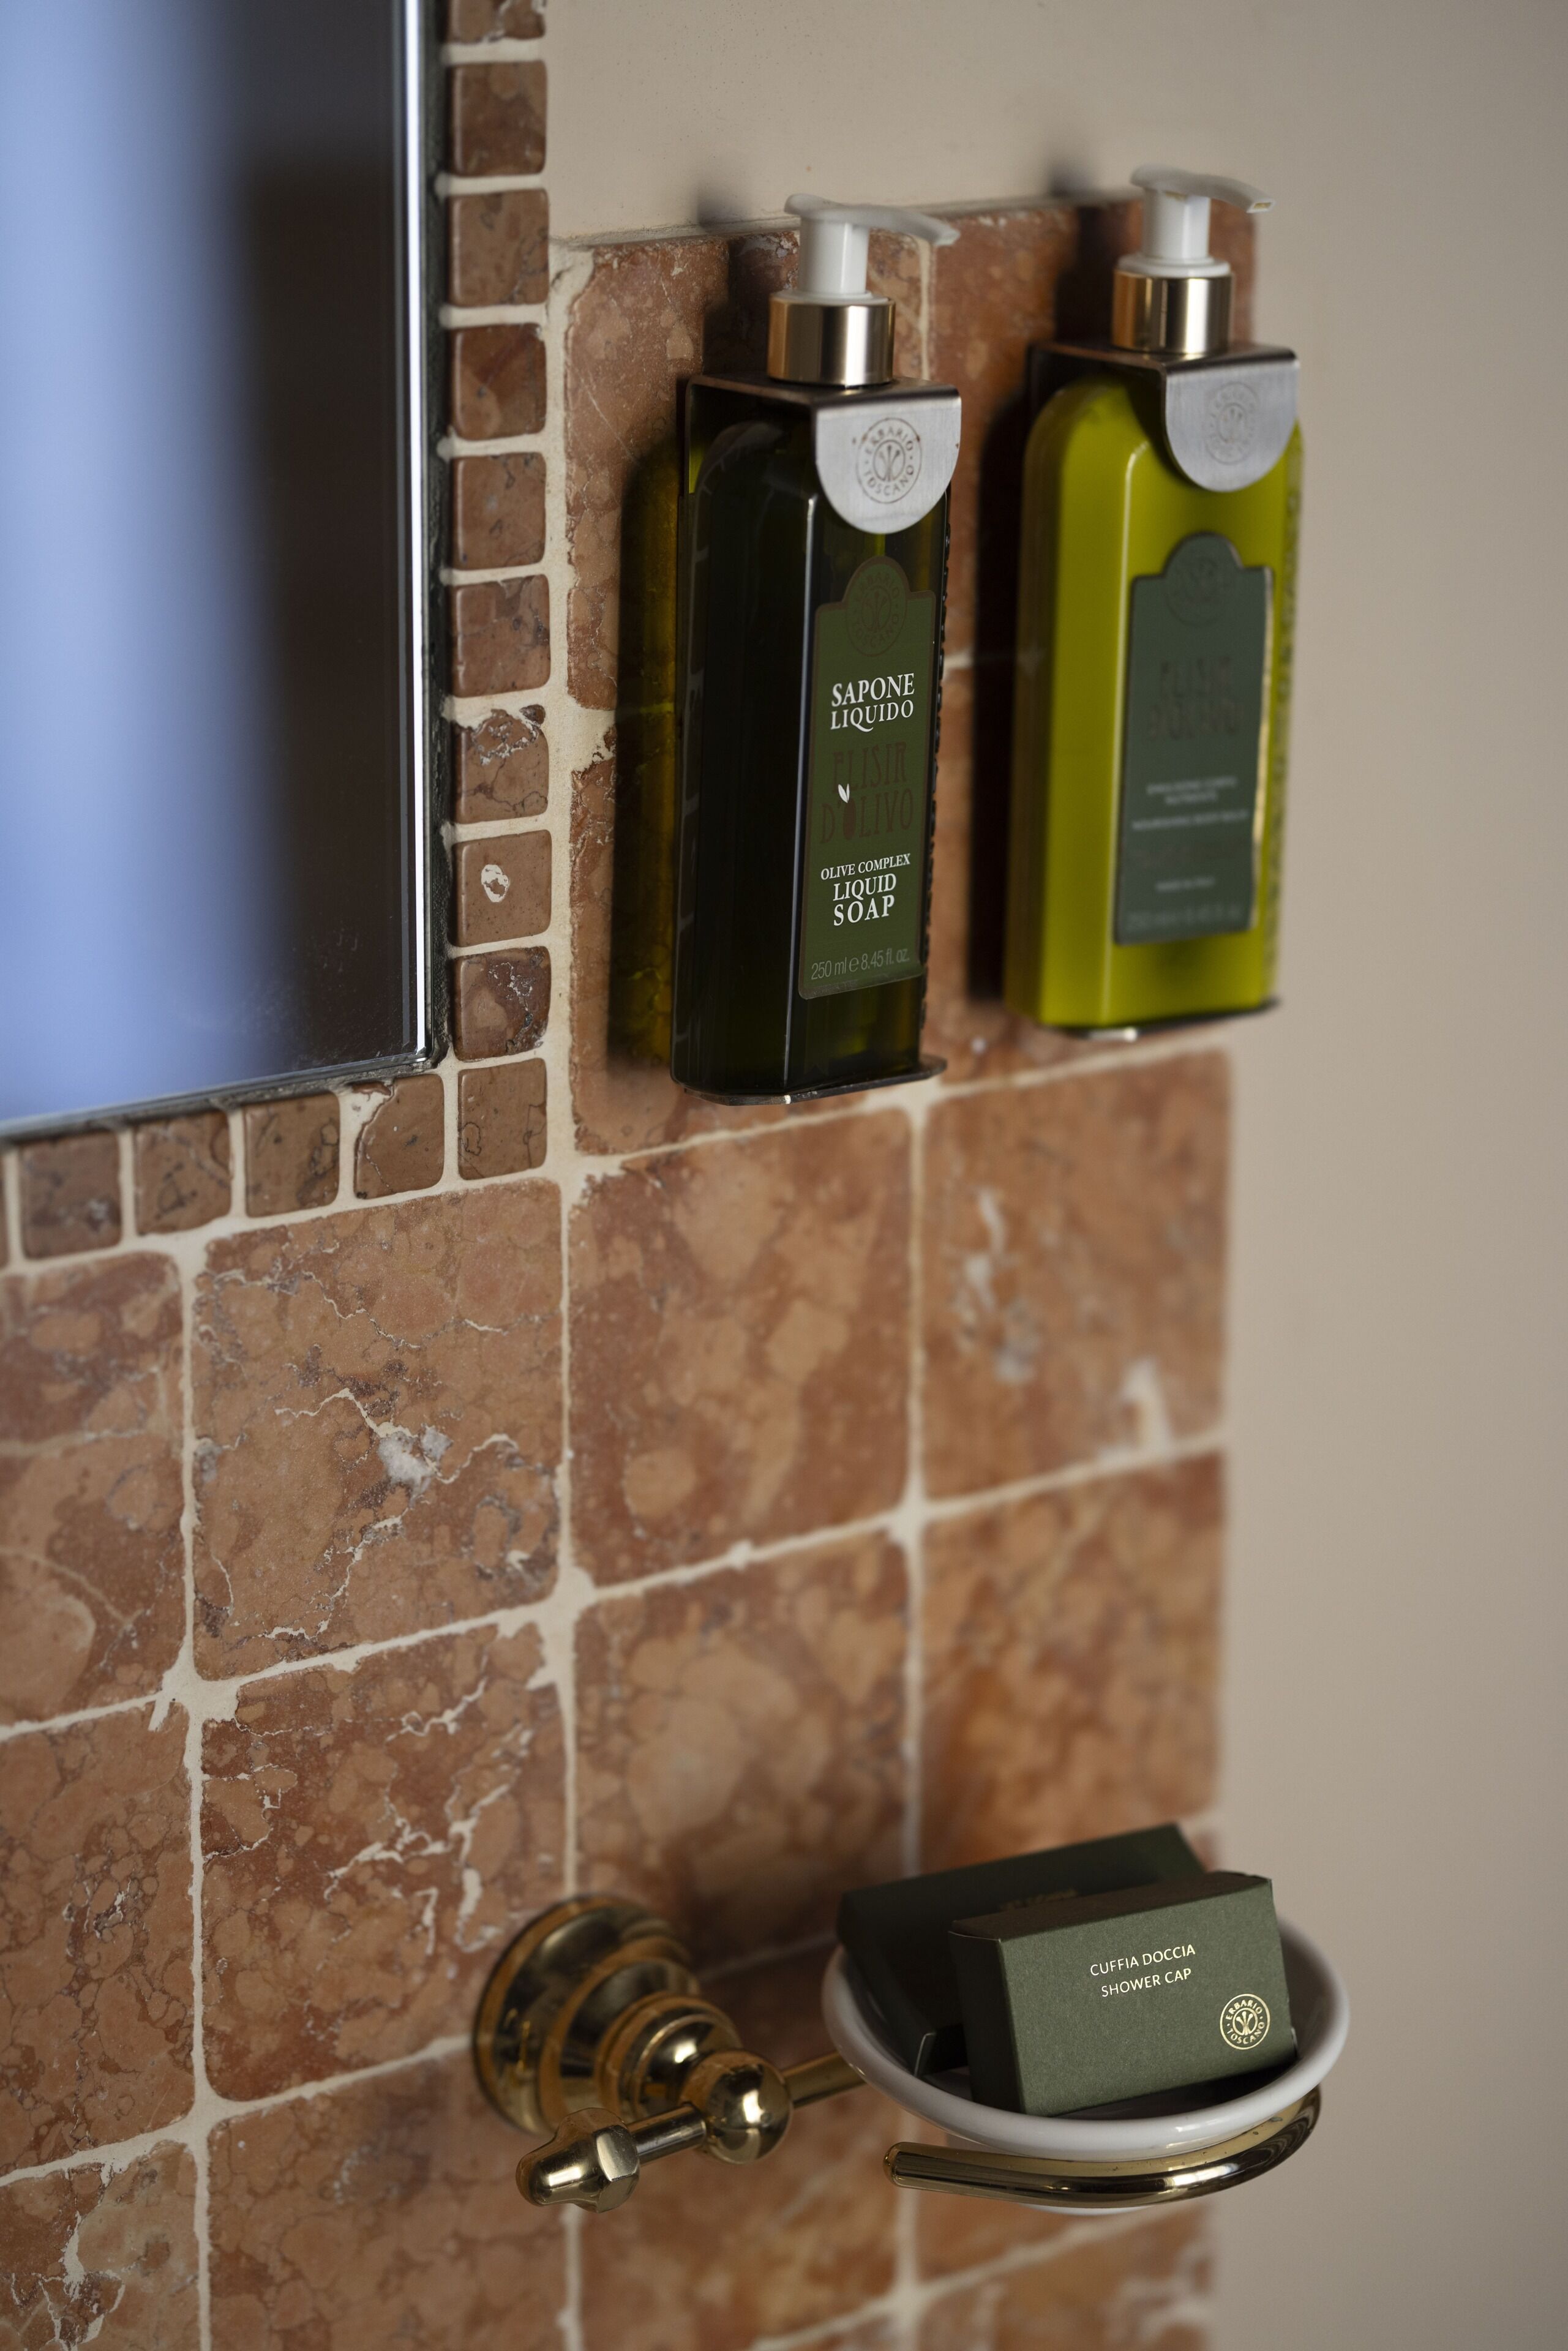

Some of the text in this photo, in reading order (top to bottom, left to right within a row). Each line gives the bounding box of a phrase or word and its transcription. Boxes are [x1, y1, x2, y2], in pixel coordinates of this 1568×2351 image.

[863, 464, 914, 497] TOSCANO
[831, 673, 915, 707] SAPONE
[830, 699, 914, 732] LIQUIDO
[832, 741, 907, 793] ELISIR
[820, 853, 911, 880] OLIVE COMPLEX
[833, 873, 896, 901] LIQUID
[834, 894, 895, 926] SOAP
[811, 960, 832, 980] 250
[835, 957, 847, 975] ml
[861, 950, 884, 970] 8.45
[1090, 1944, 1196, 1976] CUFFIA DOCCIA
[1101, 1968, 1191, 1997] SHOWER CAP
[1225, 1999, 1263, 2020] ERBARIO
[1226, 2021, 1266, 2045] TOSCANO
